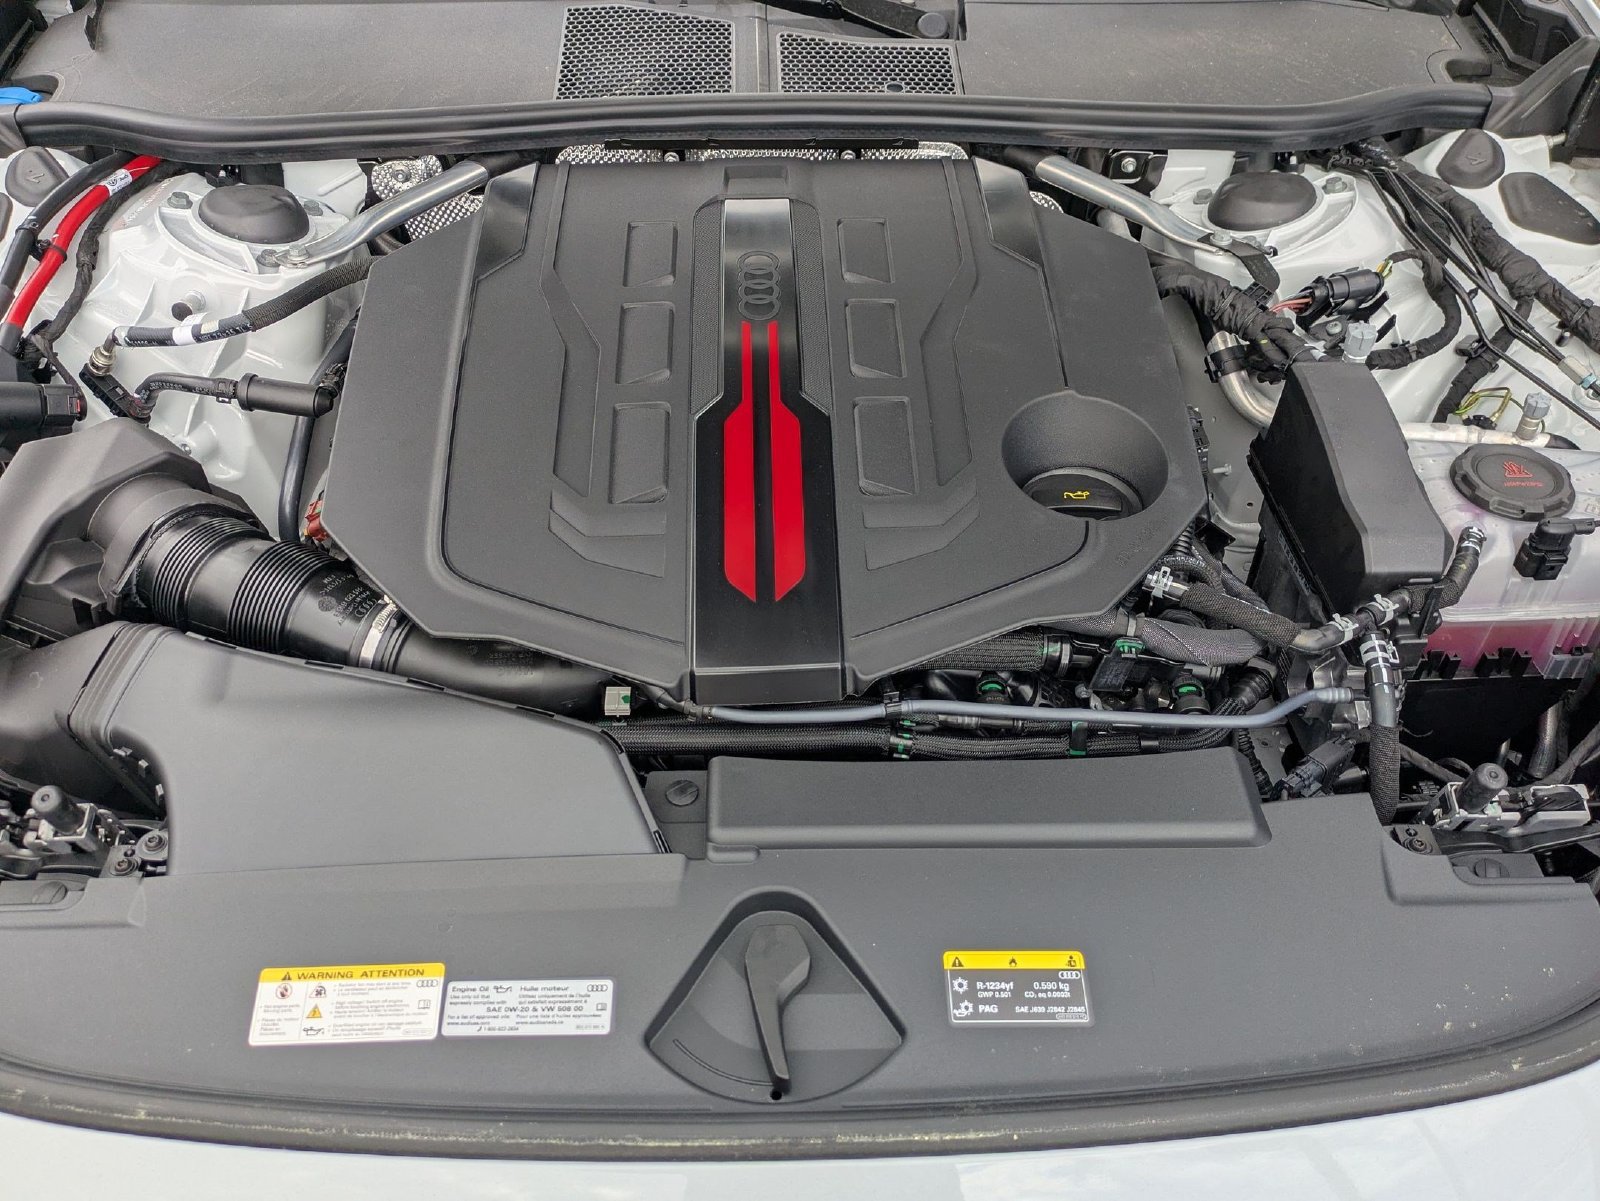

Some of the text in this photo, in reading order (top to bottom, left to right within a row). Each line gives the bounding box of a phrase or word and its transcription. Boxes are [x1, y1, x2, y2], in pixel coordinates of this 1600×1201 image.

[297, 968, 425, 980] WARNING ATTENTION
[451, 985, 477, 993] Engine
[976, 981, 1070, 992] R-1234yf 0.590 kg
[978, 1004, 999, 1013] PAG
